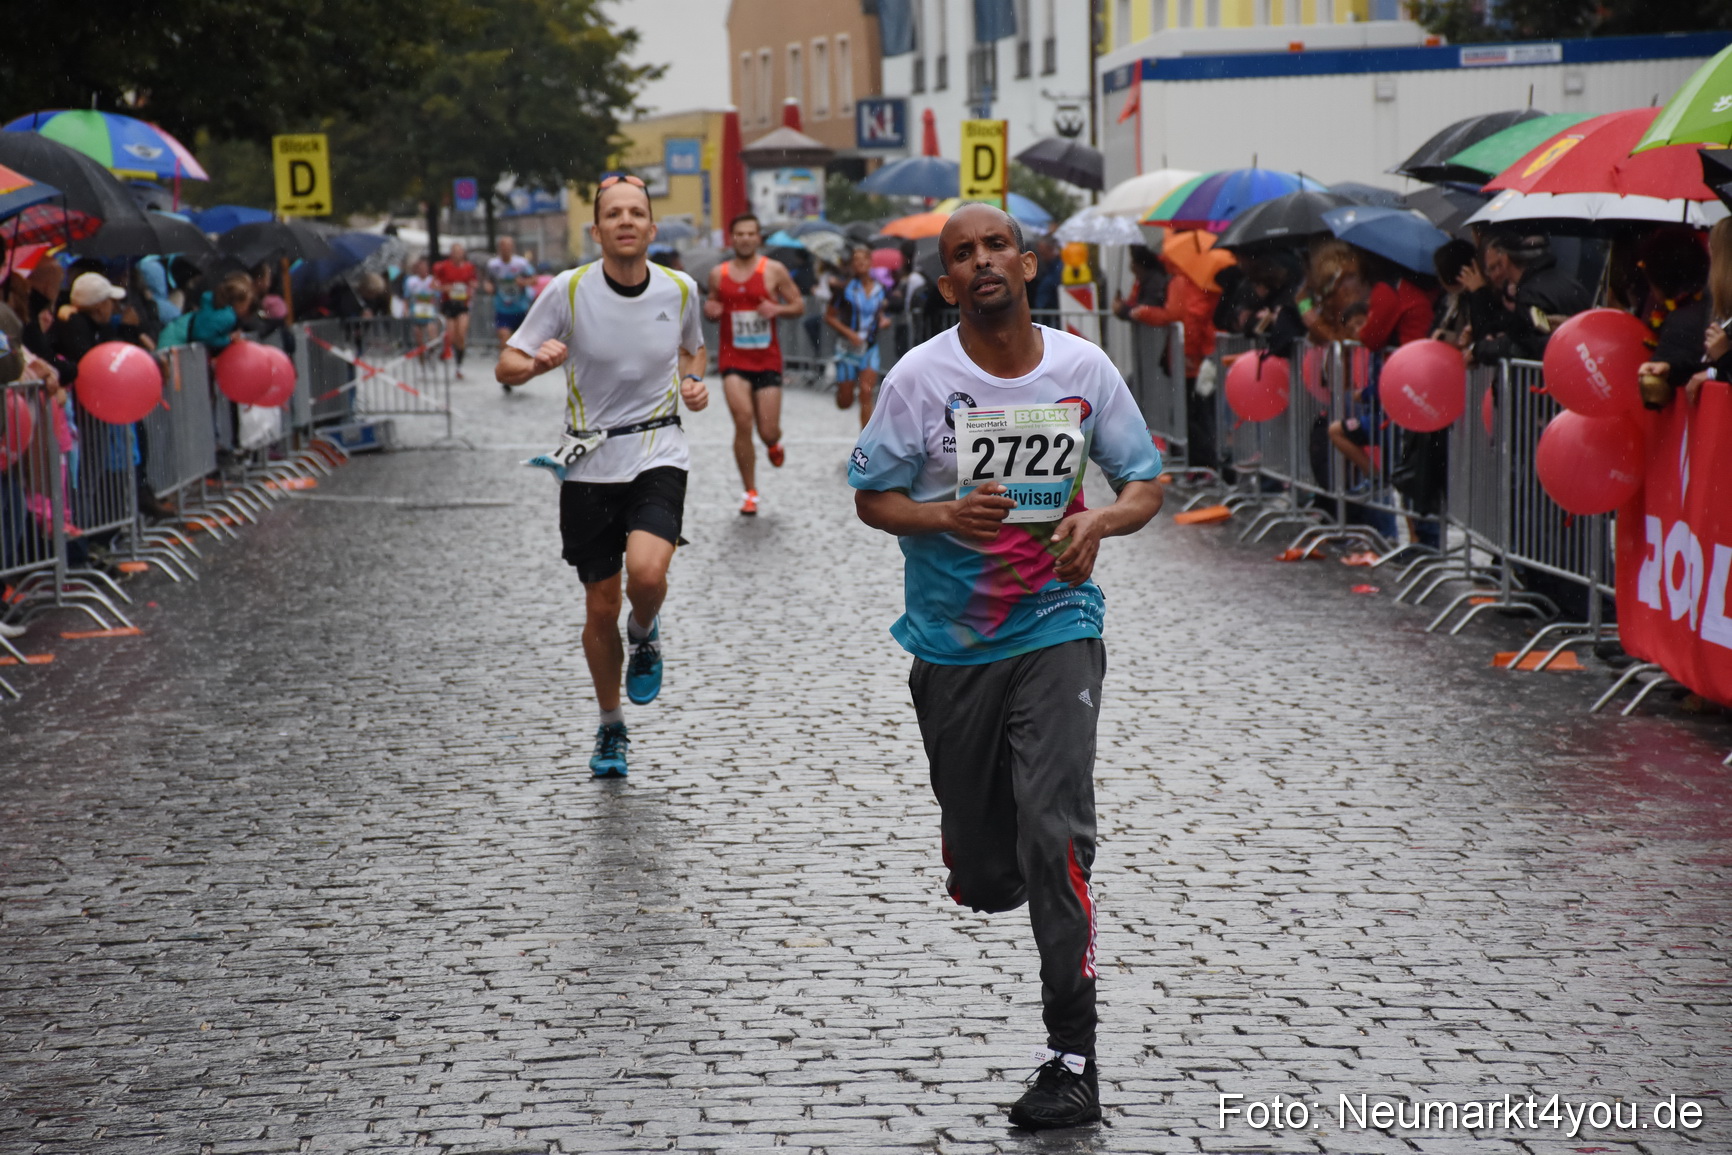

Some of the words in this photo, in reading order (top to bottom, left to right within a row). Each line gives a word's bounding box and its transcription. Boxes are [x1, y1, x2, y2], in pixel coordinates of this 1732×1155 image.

[289, 159, 315, 197] D
[973, 145, 996, 181] D
[966, 420, 1007, 429] NeuerMarkt
[1014, 408, 1069, 424] BOCK
[971, 432, 1075, 480] 2722
